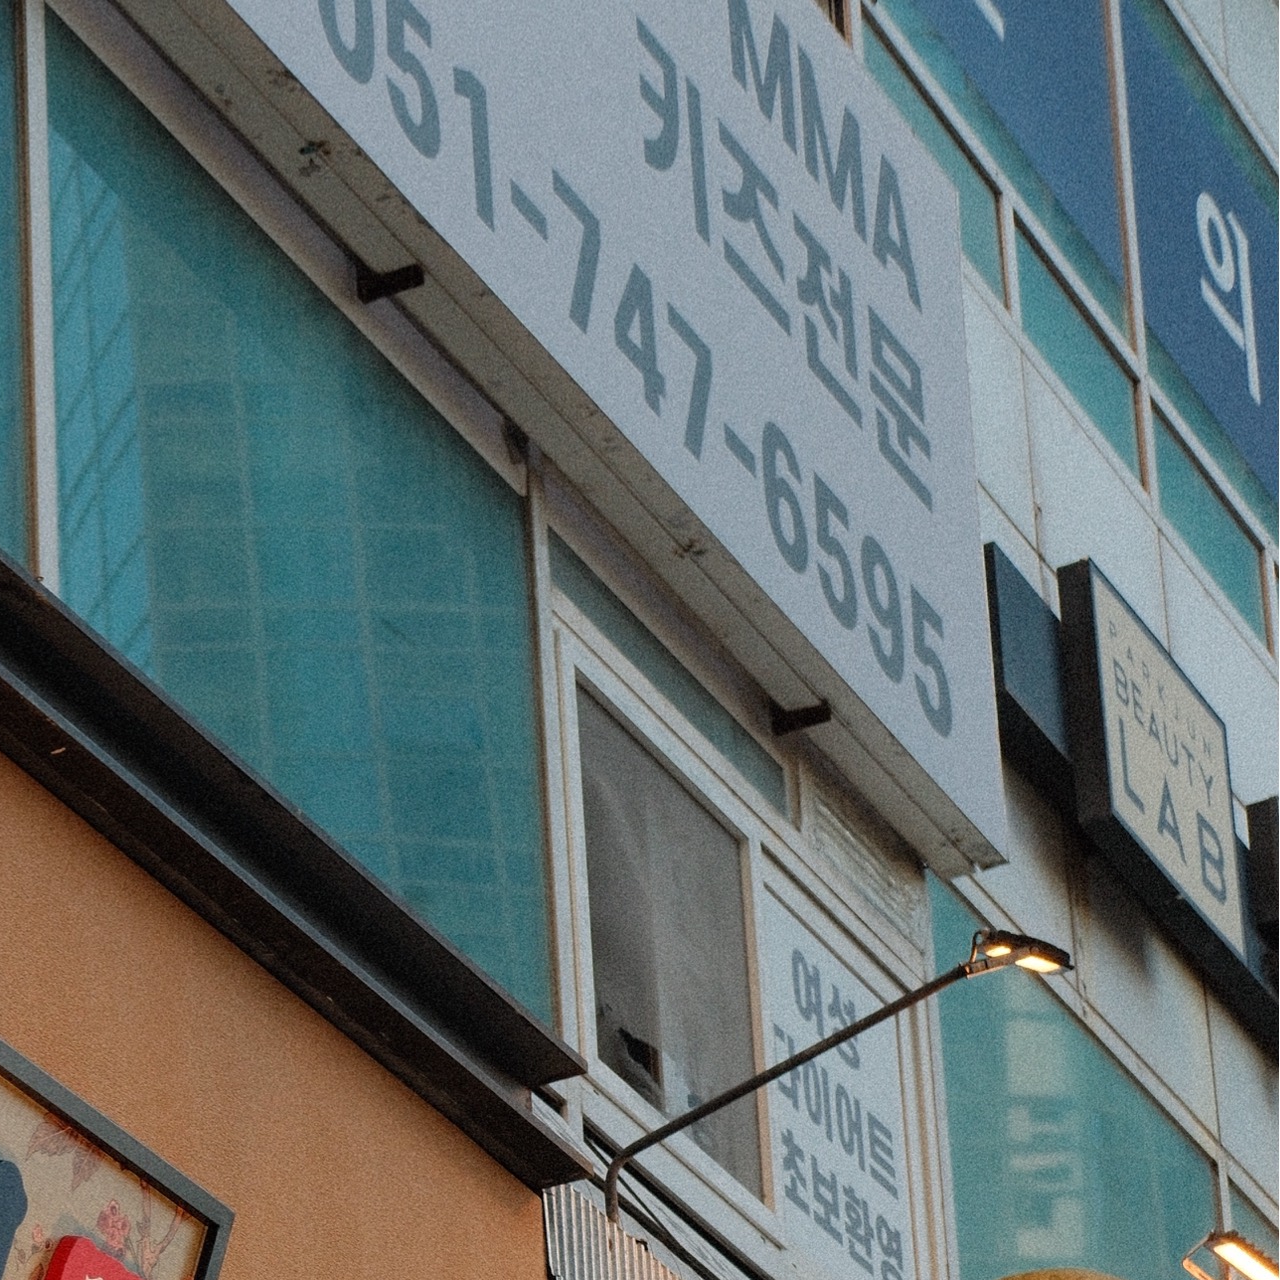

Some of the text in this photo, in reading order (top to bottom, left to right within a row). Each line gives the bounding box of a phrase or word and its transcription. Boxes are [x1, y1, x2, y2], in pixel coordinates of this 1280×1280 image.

[728, 0, 922, 314] MMA
[1113, 657, 1215, 807] BEAUTY
[1119, 714, 1227, 906] LAB
